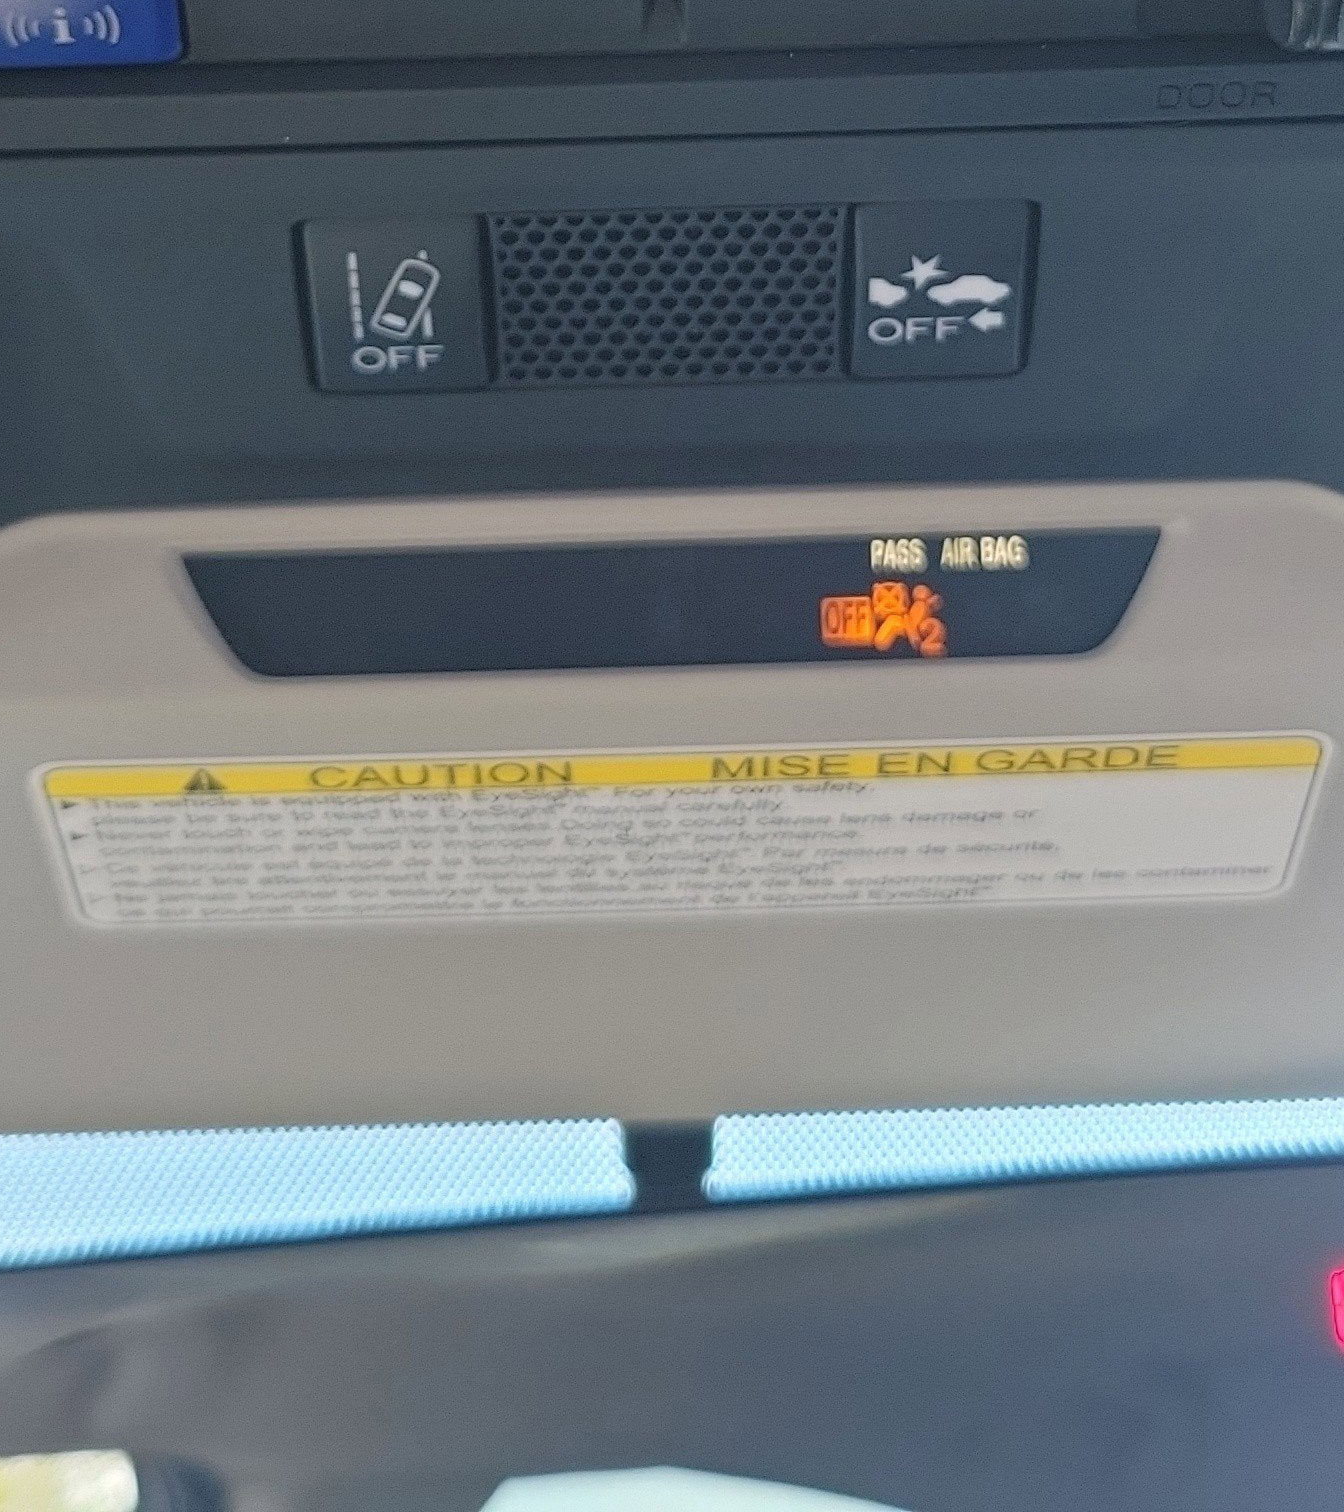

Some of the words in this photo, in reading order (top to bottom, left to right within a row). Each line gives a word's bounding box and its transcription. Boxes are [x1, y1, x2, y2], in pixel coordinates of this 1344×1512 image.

[1155, 80, 1278, 110] DOOR
[867, 314, 970, 345] OFF
[350, 344, 444, 373] OFF
[870, 537, 927, 572] PASS
[824, 601, 869, 636] OFF
[310, 762, 574, 789] CAUTION
[711, 754, 850, 780] MISE
[877, 750, 952, 776] EN
[975, 744, 1180, 774] GARDE
